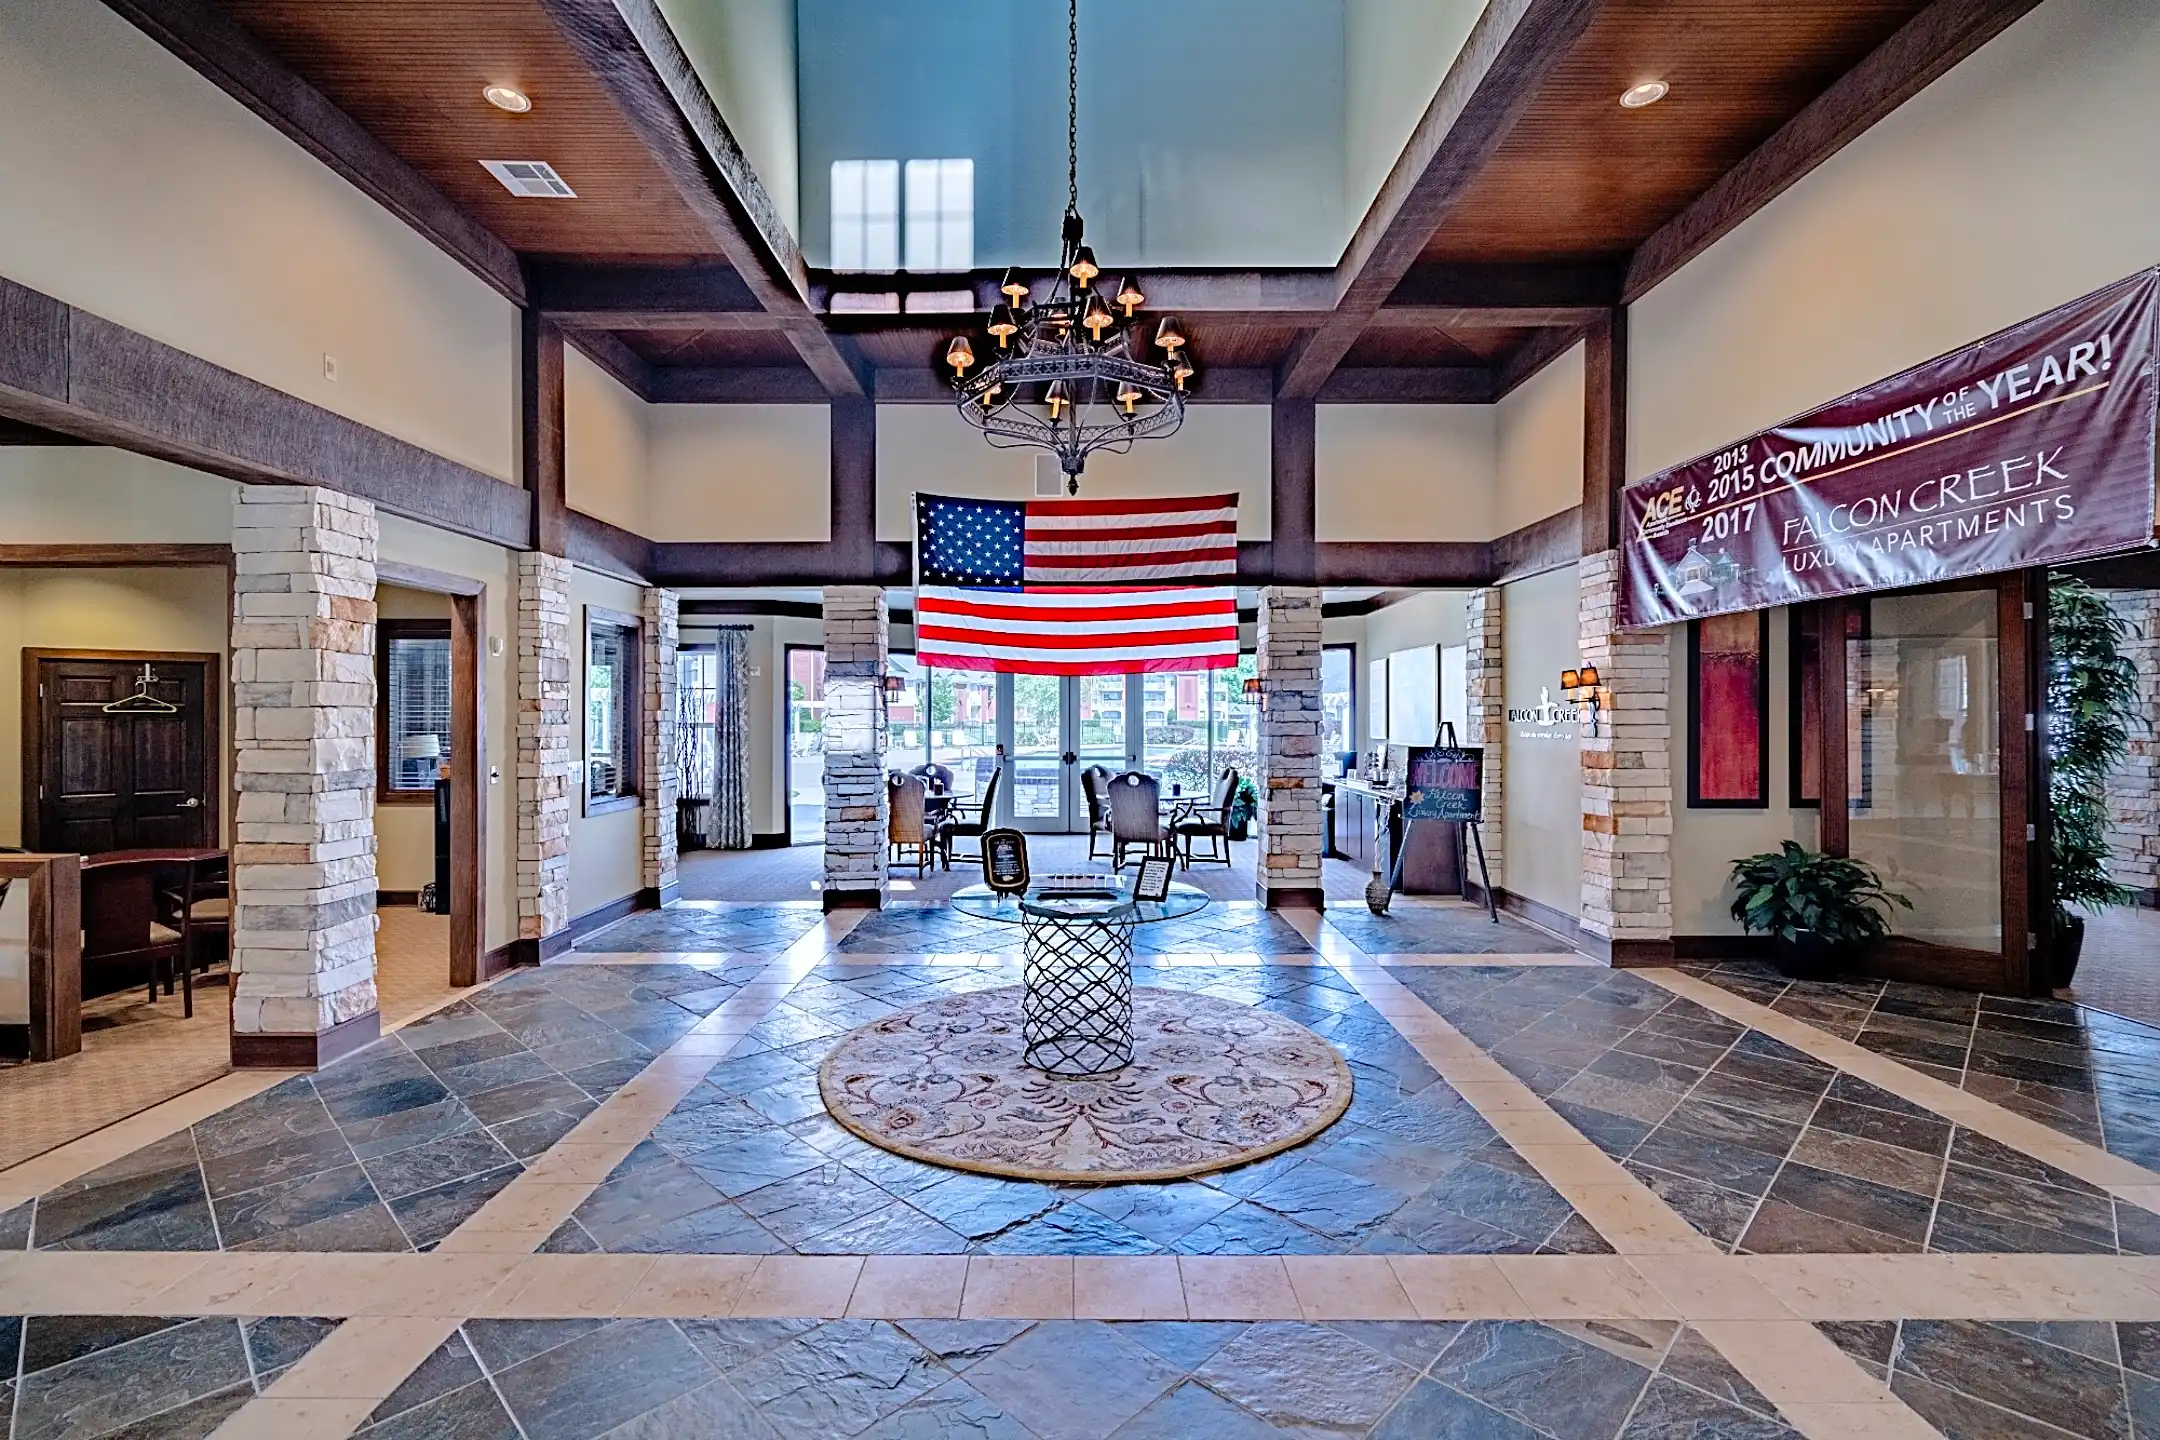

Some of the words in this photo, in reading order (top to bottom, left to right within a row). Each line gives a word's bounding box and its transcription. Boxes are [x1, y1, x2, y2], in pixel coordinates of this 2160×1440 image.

[1977, 333, 2112, 410] YEAR!
[1942, 386, 1969, 407] OF
[1942, 402, 1977, 424] THE
[1713, 444, 1748, 475] 2013
[1760, 397, 1938, 484] COMMUNITY
[1707, 465, 1755, 504] 2015
[1783, 489, 1901, 545] FALCON
[1909, 446, 2068, 512] CREEK
[1640, 486, 1684, 530] ACE
[1701, 502, 1757, 544] 2017
[1782, 541, 1861, 575] LUXURY
[1871, 494, 2075, 555] APARTMENTS
[1411, 763, 1480, 789] WELCOME
[1425, 788, 1467, 802] Falcon
[1436, 799, 1468, 810] Creek
